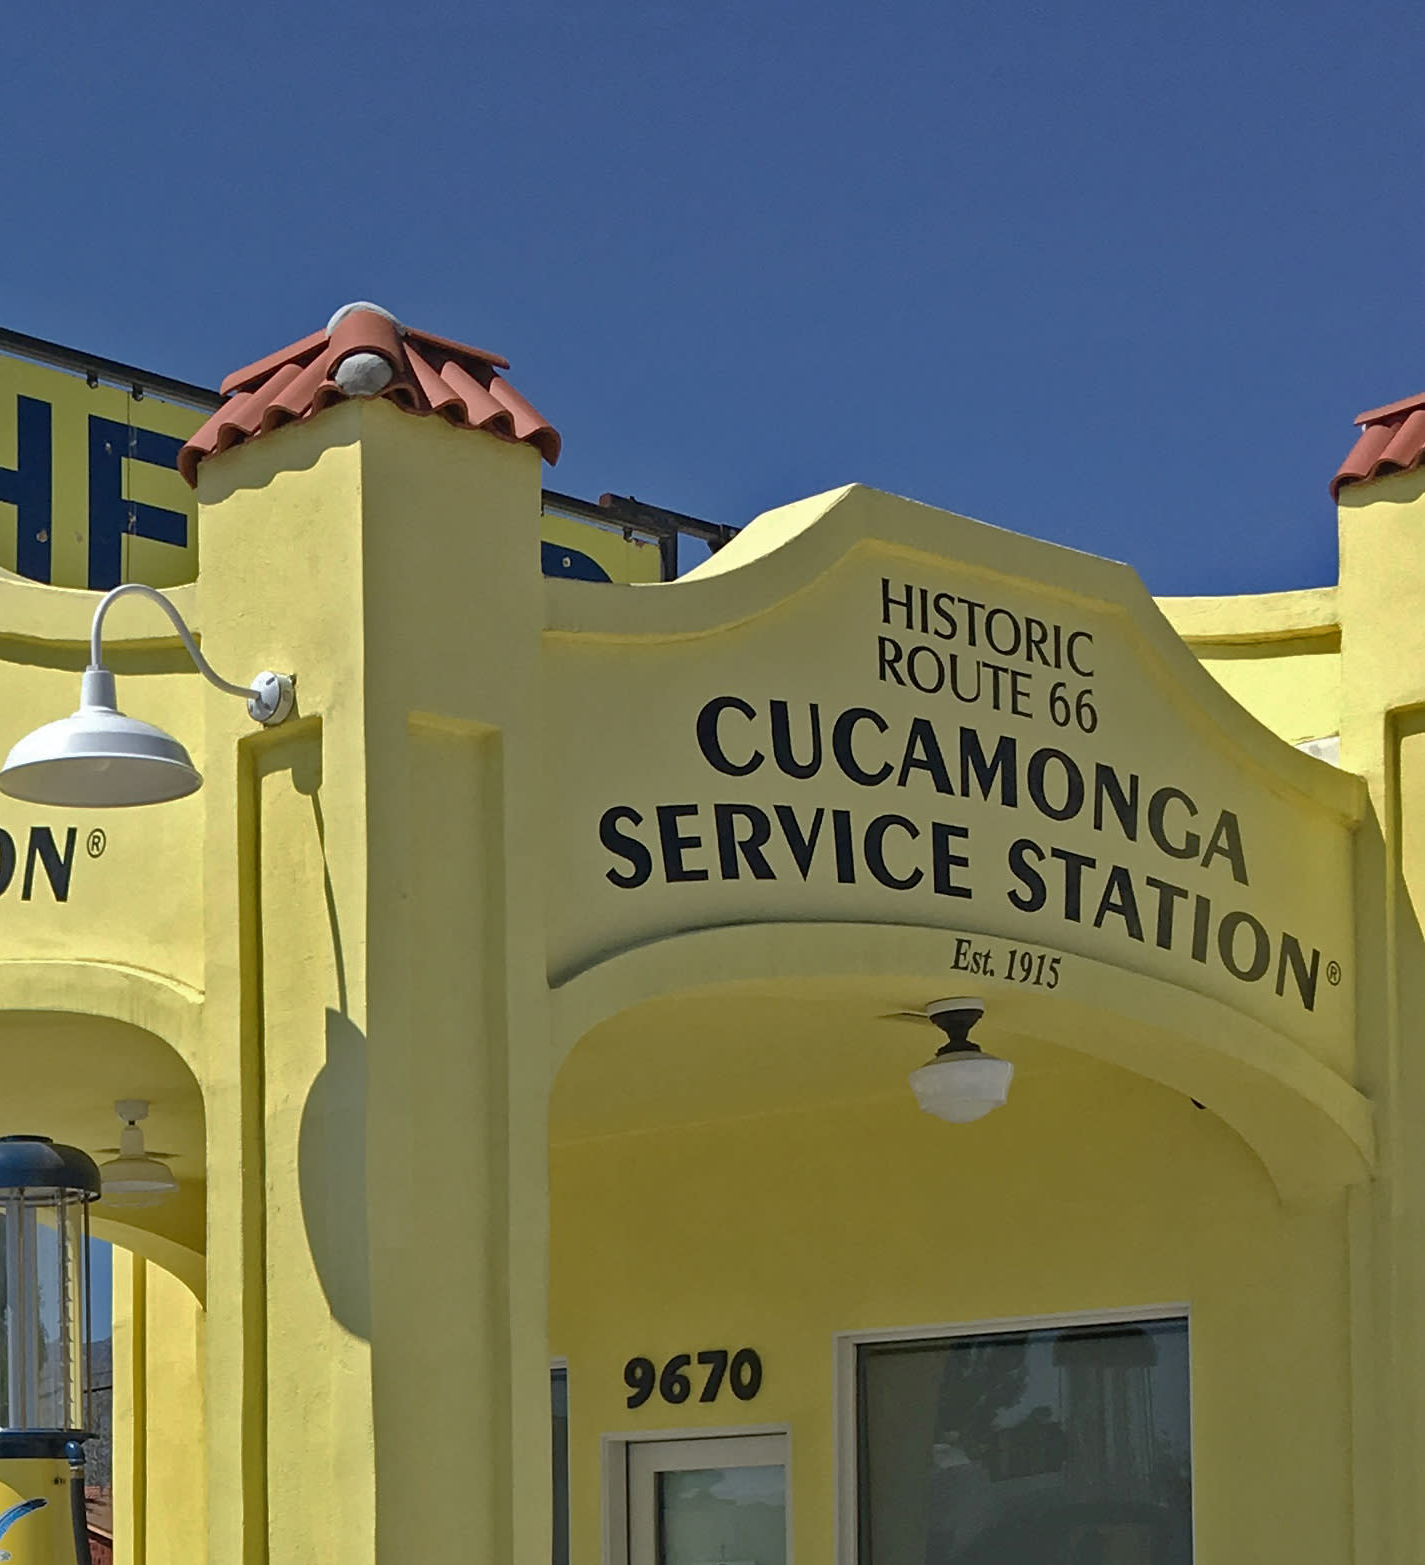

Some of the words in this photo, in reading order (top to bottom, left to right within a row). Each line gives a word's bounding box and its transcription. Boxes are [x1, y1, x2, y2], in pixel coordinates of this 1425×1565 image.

[881, 577, 1095, 679] HISTORIC
[876, 635, 1034, 720] ROUTE
[1049, 680, 1099, 734] 66
[696, 696, 1249, 887] CUCAMONGA
[599, 803, 973, 900] SERVICE
[950, 938, 996, 979] Est.
[1003, 949, 1063, 990] 1915
[623, 1347, 764, 1410] 9670
